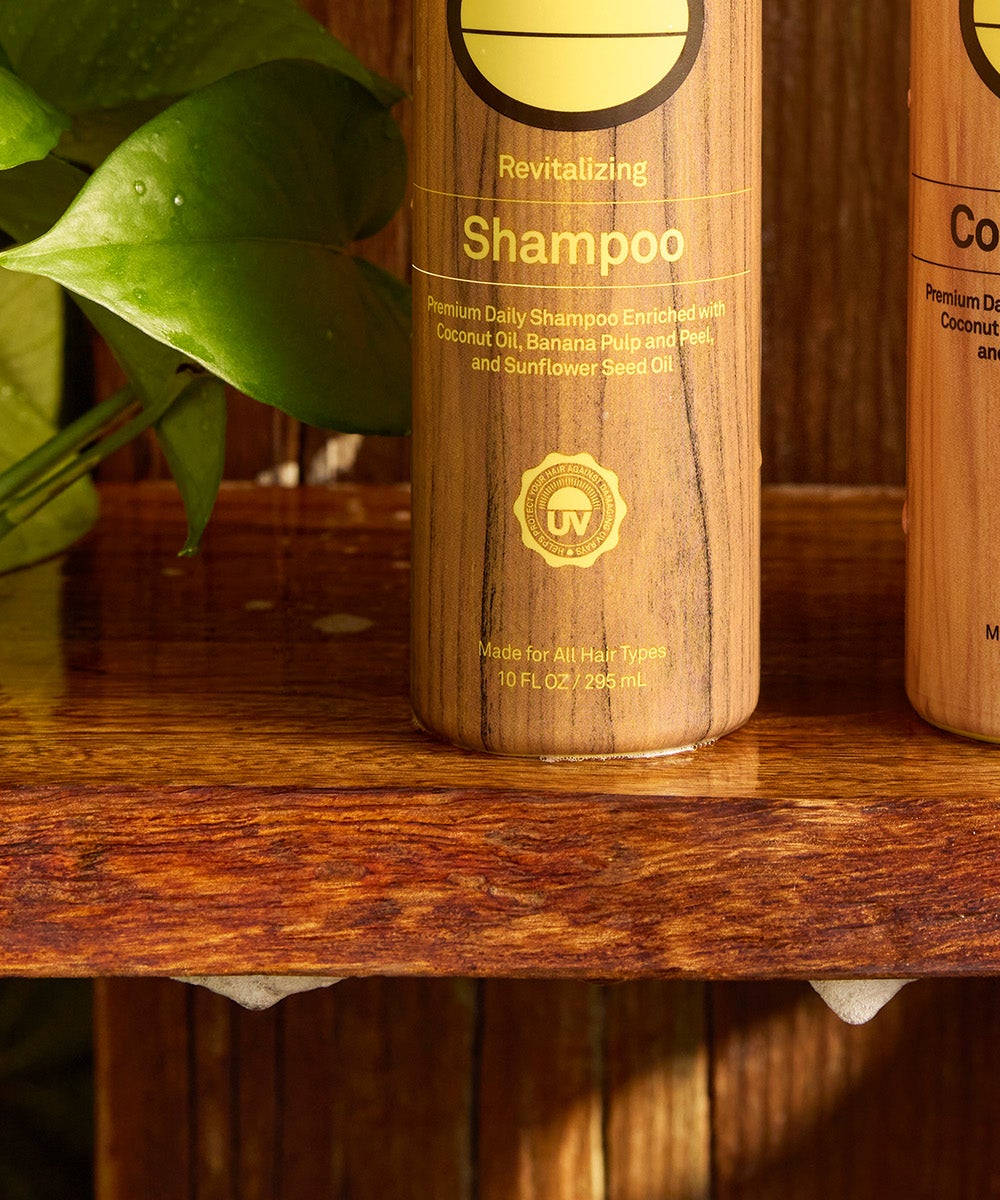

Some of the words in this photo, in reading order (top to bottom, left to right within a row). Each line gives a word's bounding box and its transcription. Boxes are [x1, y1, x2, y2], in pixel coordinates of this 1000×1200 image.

[499, 154, 648, 186] Revitalizing
[463, 216, 684, 276] Shampoo
[926, 283, 980, 310] Premium
[427, 296, 481, 321] Premium
[485, 305, 527, 328] Daily
[530, 309, 618, 329] Shampoo
[623, 303, 696, 325] Enriched
[699, 300, 726, 319] with
[941, 312, 999, 336] Coconut
[437, 323, 492, 347] Coconut
[496, 331, 523, 352] Oil,
[527, 336, 596, 352] Banana
[601, 333, 641, 354] Pulp
[645, 330, 676, 349] and
[680, 326, 714, 346] Peel,
[472, 356, 500, 373] and
[504, 356, 598, 377] Sunflower
[602, 357, 647, 376] Seed
[651, 353, 673, 374] Oil
[546, 465, 566, 476] HAIR
[567, 465, 602, 484] AGAINST
[530, 475, 547, 496] YOUR
[527, 498, 540, 536] PROTECT
[600, 483, 613, 531] DAMAGING
[547, 511, 592, 536] UV
[539, 535, 564, 555] HELPS
[576, 541, 596, 555] RAYS
[596, 532, 606, 543] UV
[478, 641, 522, 661] Made
[527, 645, 550, 662] for
[554, 647, 575, 663] All
[581, 648, 617, 663] Hair
[620, 644, 666, 665] Types
[499, 671, 516, 687] 10
[521, 673, 541, 689] FL
[545, 674, 569, 690] OZ
[585, 673, 616, 690] 295
[621, 671, 647, 687] mL
